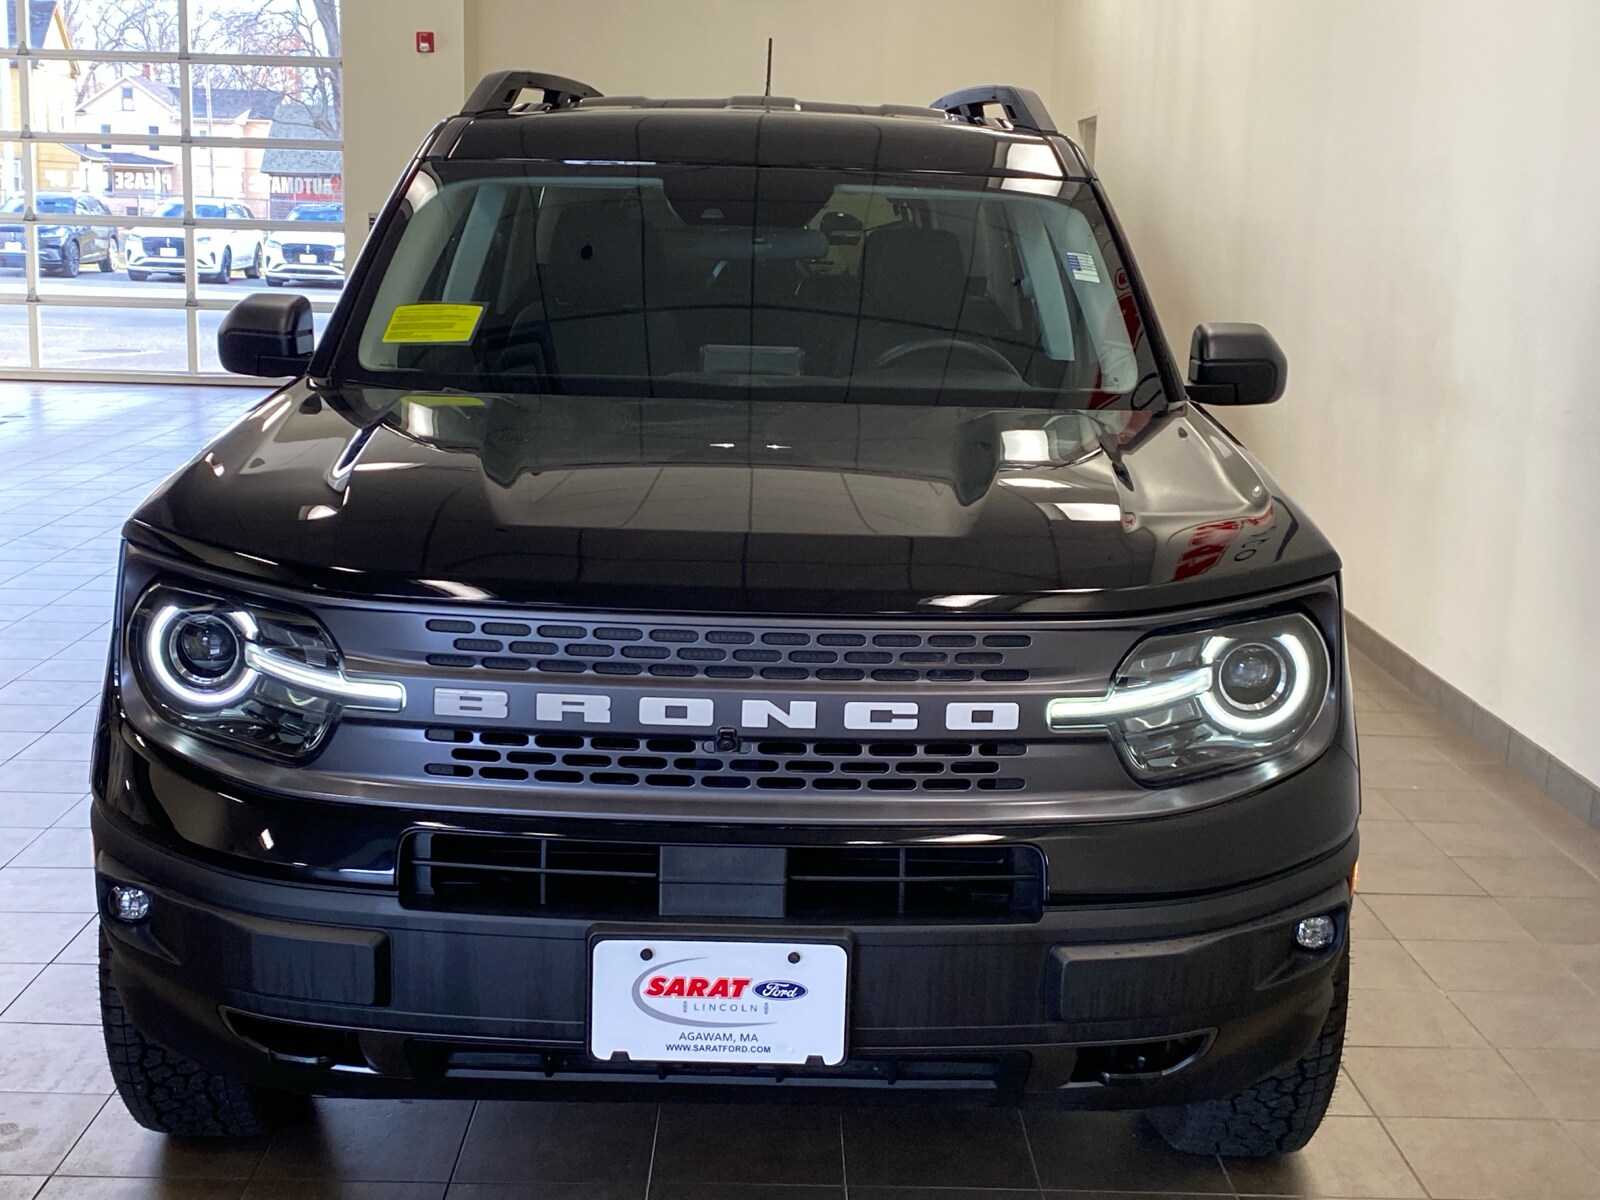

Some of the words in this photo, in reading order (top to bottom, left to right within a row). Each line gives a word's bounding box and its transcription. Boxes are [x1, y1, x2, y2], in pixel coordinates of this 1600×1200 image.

[434, 687, 1020, 731] BRONCO
[644, 976, 752, 999] SARAT
[761, 982, 799, 998] Ford
[693, 1003, 758, 1013] LINCOLN
[679, 1032, 737, 1043] AGAWAM,
[739, 1032, 759, 1042] MA
[665, 1043, 772, 1053] WWW.SARATFORD.COM
